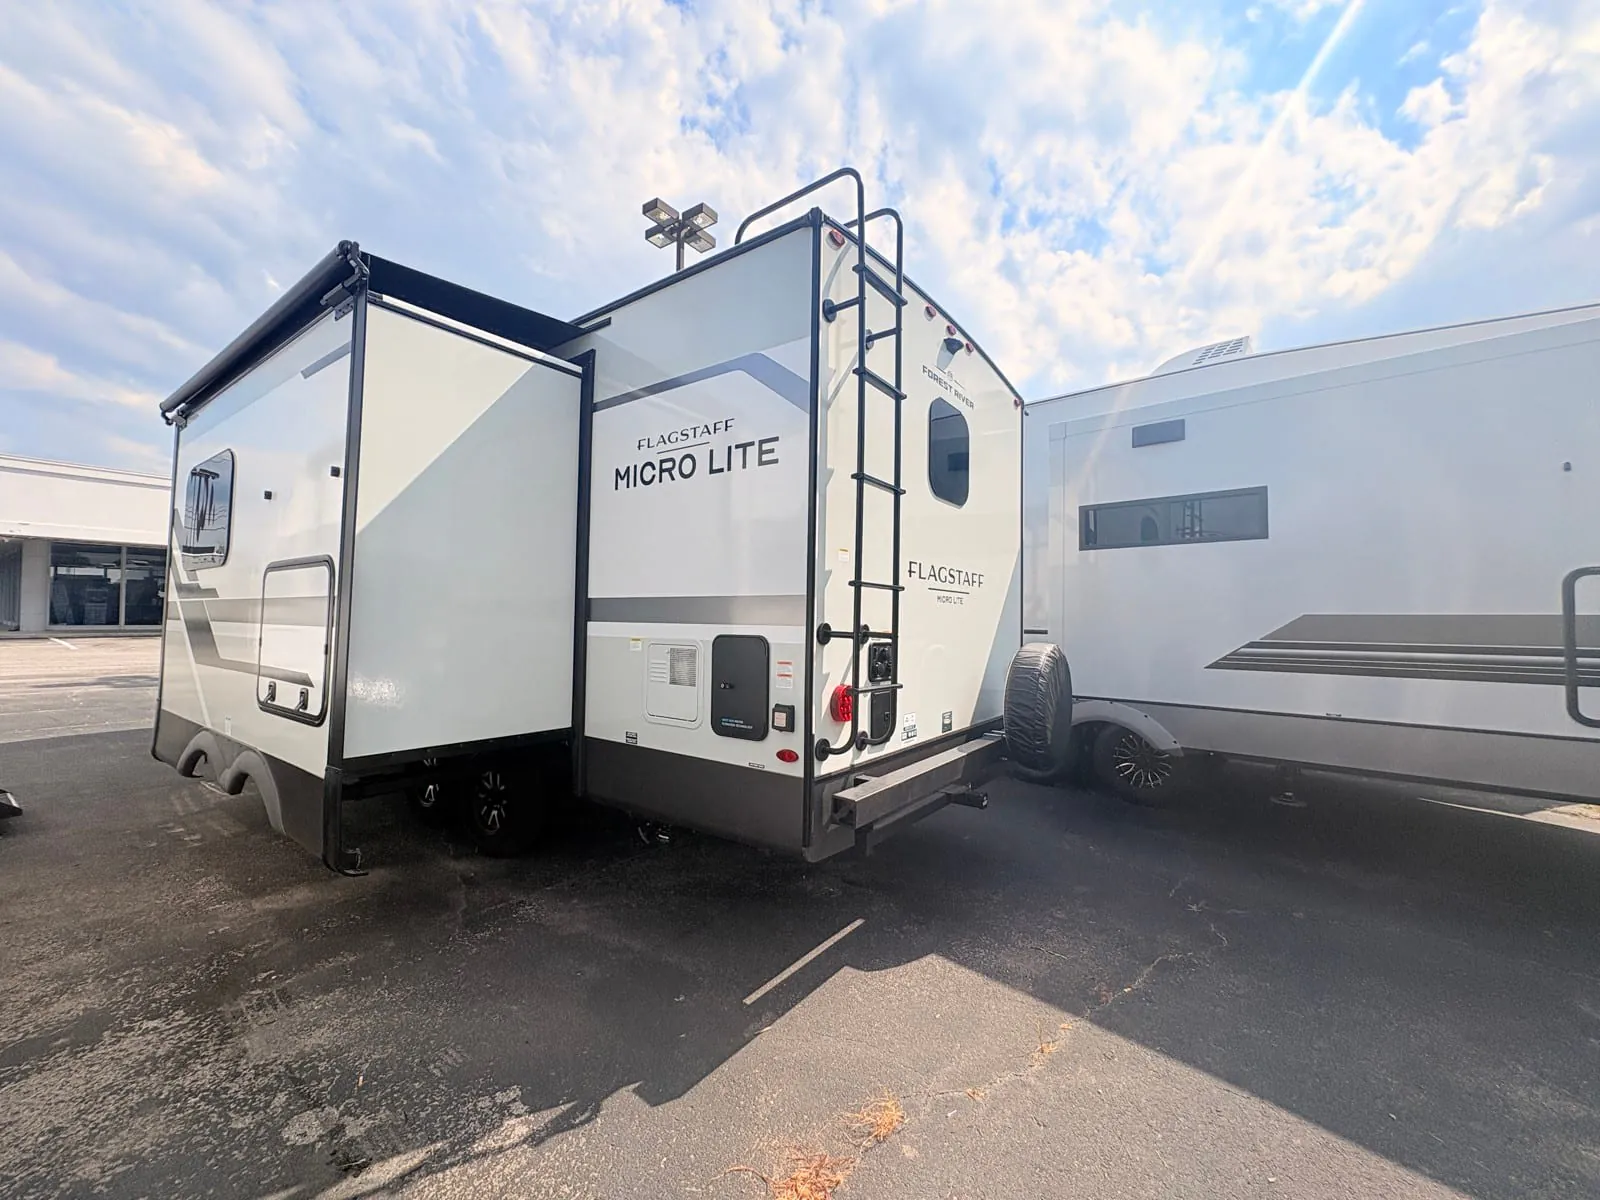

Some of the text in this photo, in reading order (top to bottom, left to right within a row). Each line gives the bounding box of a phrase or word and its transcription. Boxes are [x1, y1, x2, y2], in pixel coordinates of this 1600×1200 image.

[922, 365, 975, 411] FOREST RIVER
[637, 418, 735, 450] FLAGSTAFF
[614, 436, 780, 491] MICRO LITE
[908, 561, 985, 588] FLAGSTAFF
[936, 595, 964, 605] MICRO LITE
